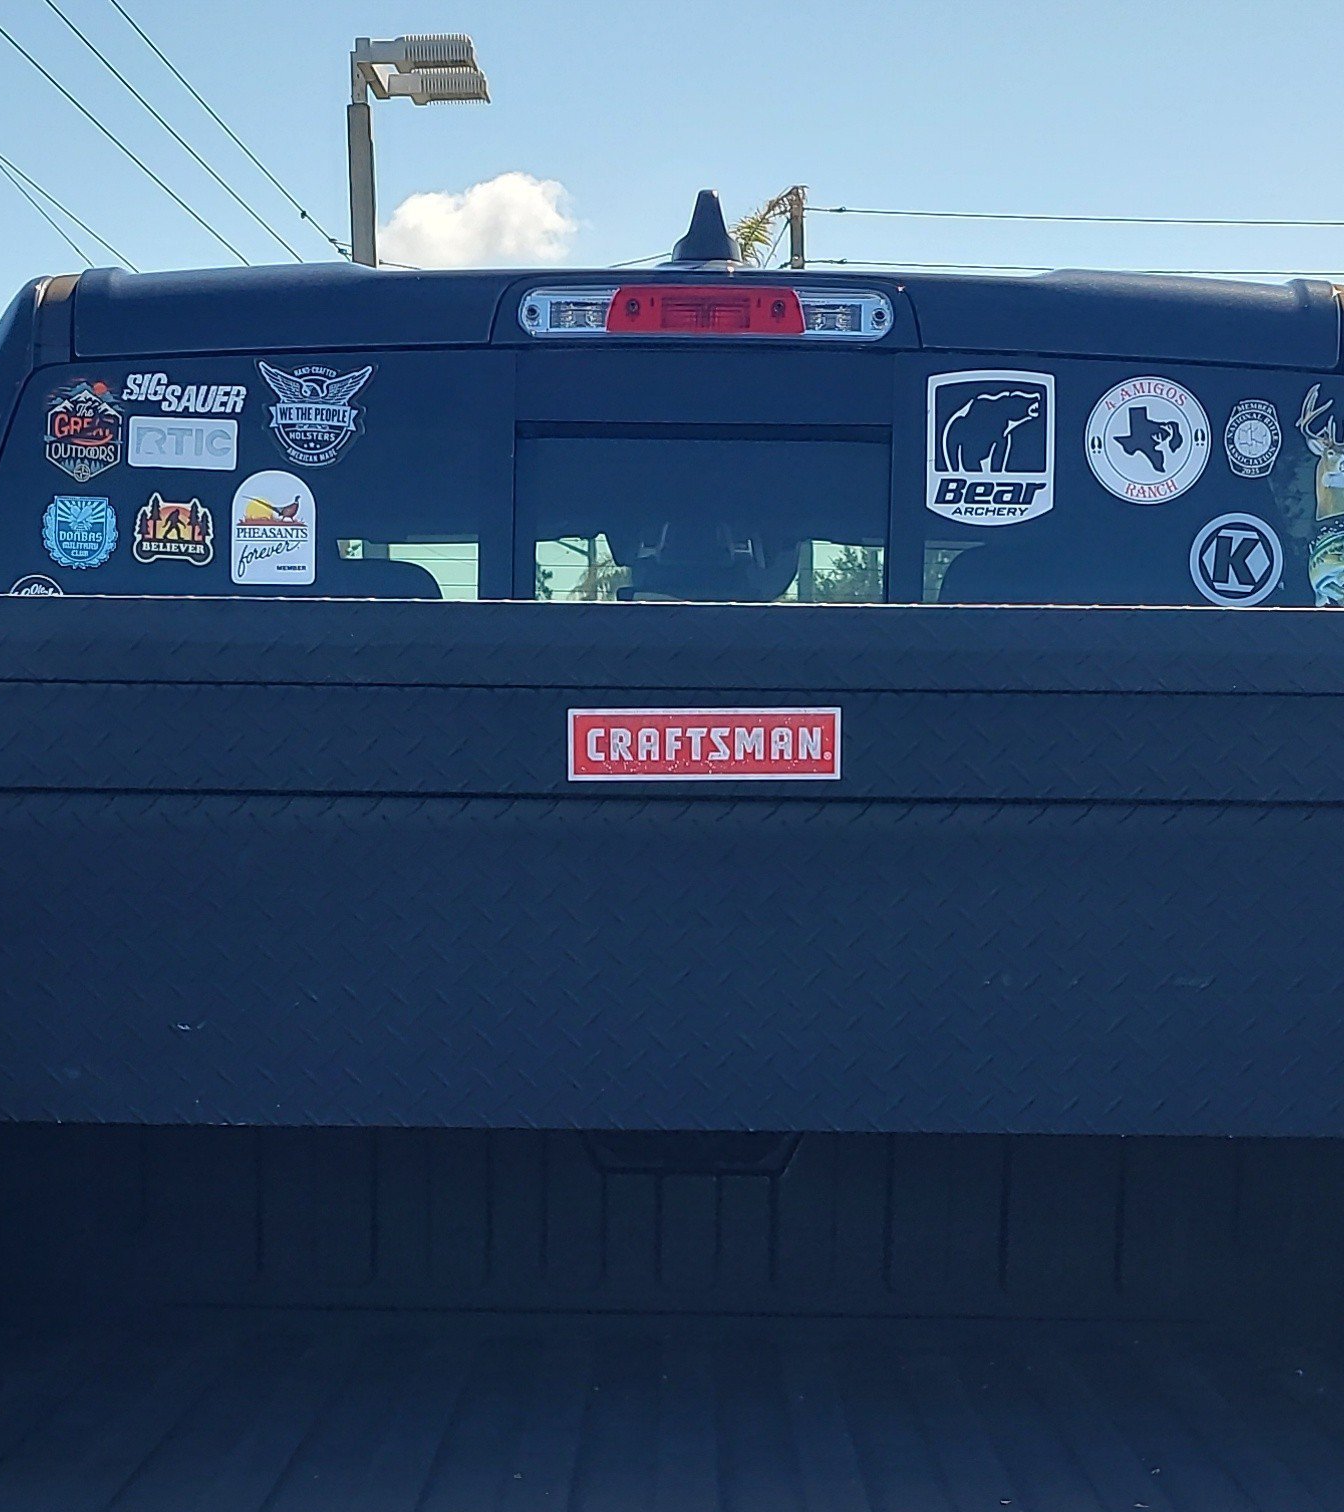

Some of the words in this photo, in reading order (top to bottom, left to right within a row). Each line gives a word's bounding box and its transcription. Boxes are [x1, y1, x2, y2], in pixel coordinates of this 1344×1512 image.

[121, 372, 168, 401] SIG
[161, 384, 247, 413] SAUER
[1104, 400, 1116, 411] 4
[1120, 381, 1188, 407] AMIGOS
[76, 401, 95, 417] The
[279, 406, 293, 421] WE
[295, 406, 313, 422] THE
[315, 407, 348, 423] PEOPLE
[1236, 402, 1273, 414] MEMBER
[289, 431, 336, 442] HOLSTERS
[1227, 413, 1263, 439] NATIONAL
[1263, 418, 1279, 441] RIFLE
[136, 426, 232, 457] RTIC
[51, 442, 115, 462] OUTDOORS
[286, 447, 318, 462] AMERICAN
[319, 448, 338, 461] MADE
[1228, 444, 1276, 465] ASSOCIATION
[934, 478, 1047, 505] Bear
[1125, 479, 1178, 499] RANCH
[951, 507, 1029, 516] ARCHERY
[236, 527, 308, 539] PHEASANTS
[141, 541, 205, 554] BELIEVER
[237, 539, 301, 578] forever
[586, 726, 823, 762] CRAFTSMAN
